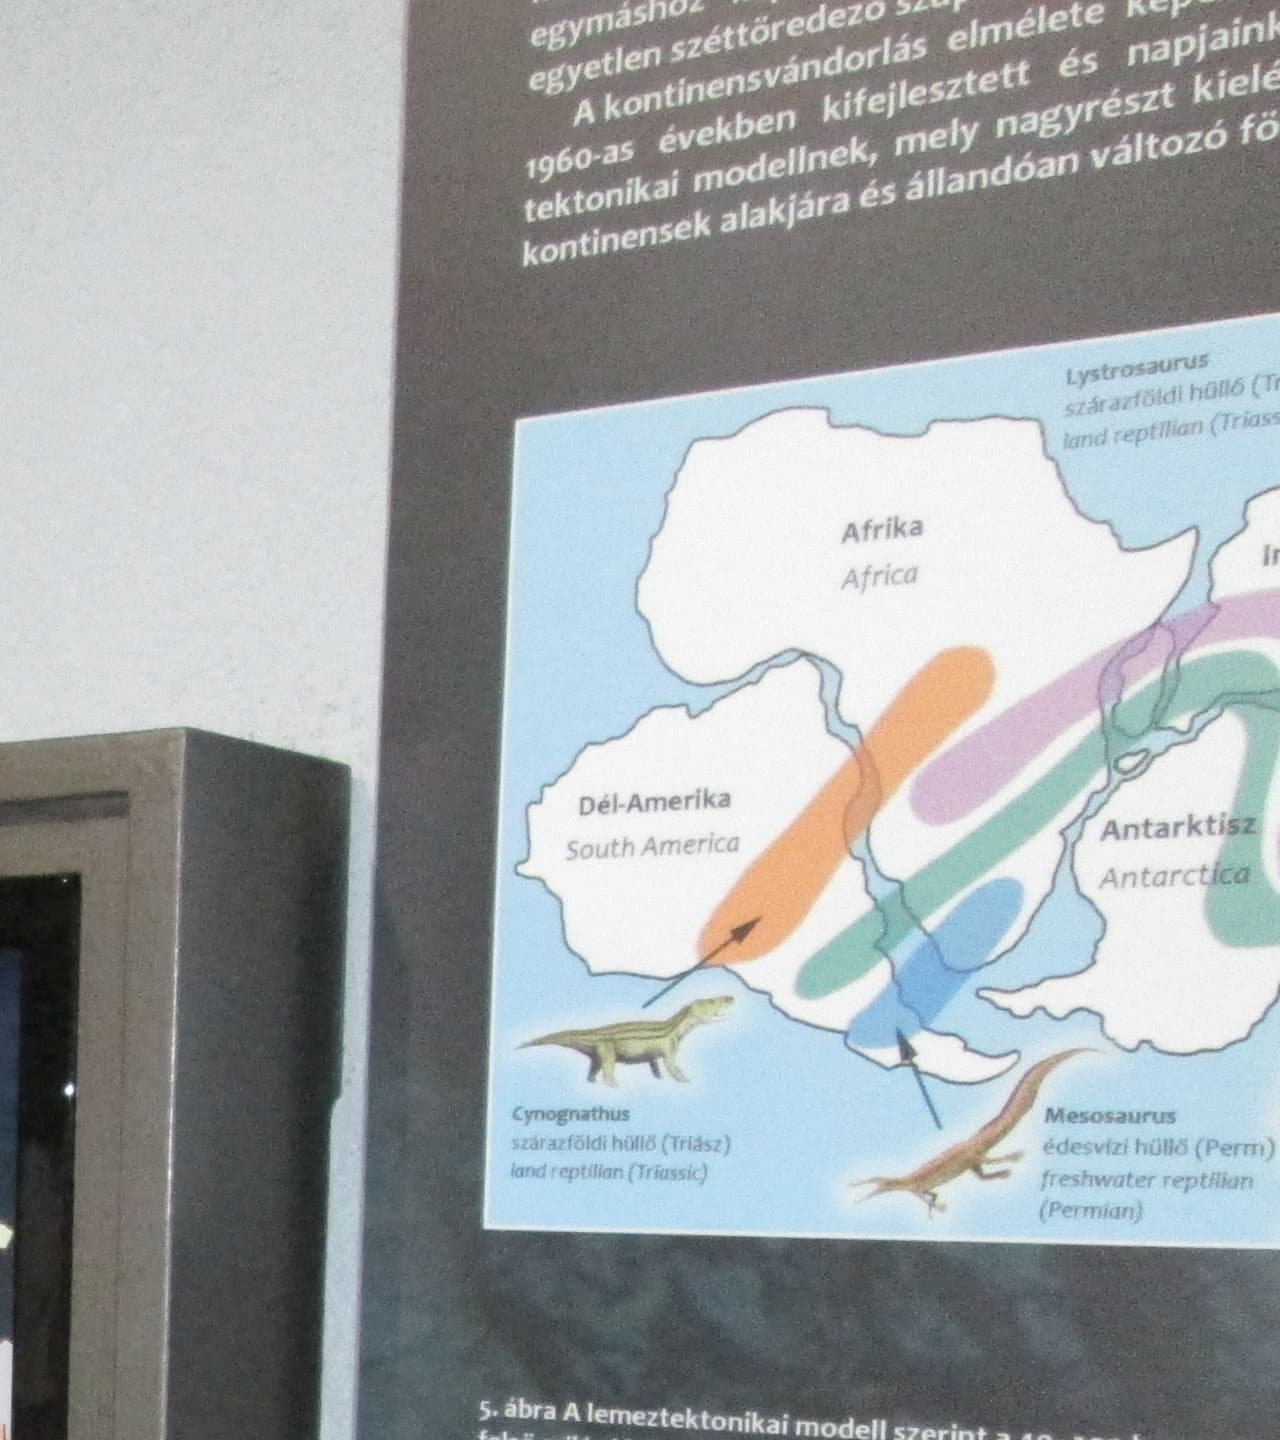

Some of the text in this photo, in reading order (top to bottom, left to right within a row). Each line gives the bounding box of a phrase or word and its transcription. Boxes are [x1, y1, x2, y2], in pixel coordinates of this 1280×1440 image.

[529, 45, 661, 96] egyetlen
[573, 0, 1105, 127] A kontinensvándorlás elmélete
[525, 140, 635, 183] 1960-as
[658, 109, 796, 154] években
[822, 59, 1031, 122] kifejlesztett
[1059, 47, 1099, 78] és
[524, 170, 679, 224] tektonikai
[693, 135, 879, 193] modellnek,
[895, 117, 980, 156] mely
[995, 81, 1176, 140] nagyrészt
[522, 209, 712, 268] kontinensek
[720, 189, 850, 230] alakjára
[858, 179, 896, 208] és
[904, 150, 1080, 202] állandóan
[1089, 119, 1228, 170] változó
[1066, 353, 1209, 389] Lystrosaurus
[1114, 420, 1203, 447] reptilian
[841, 516, 924, 544] Afrika
[841, 562, 919, 595] Africa
[579, 787, 732, 817] Dél-Amerika
[1100, 812, 1257, 841] Antarktisz
[566, 832, 740, 861] South America
[1099, 861, 1251, 889] Antarctica
[512, 1106, 631, 1126] Cynognathus
[1045, 1107, 1177, 1125] Mesosaurus
[661, 1134, 732, 1156] (Triász)
[1043, 1138, 1128, 1156] édesvízi
[1195, 1137, 1276, 1161] (Perm)
[511, 1162, 708, 1186] land reptilian (Triassic)
[1041, 1170, 1254, 1193] freshwater reptilian
[1040, 1200, 1143, 1225] (Permian)
[479, 1400, 498, 1421] 5.
[504, 1397, 557, 1420] ábra
[563, 1402, 581, 1421] A
[587, 1403, 788, 1435] lemeztektonikai
[795, 1418, 887, 1440] modell
